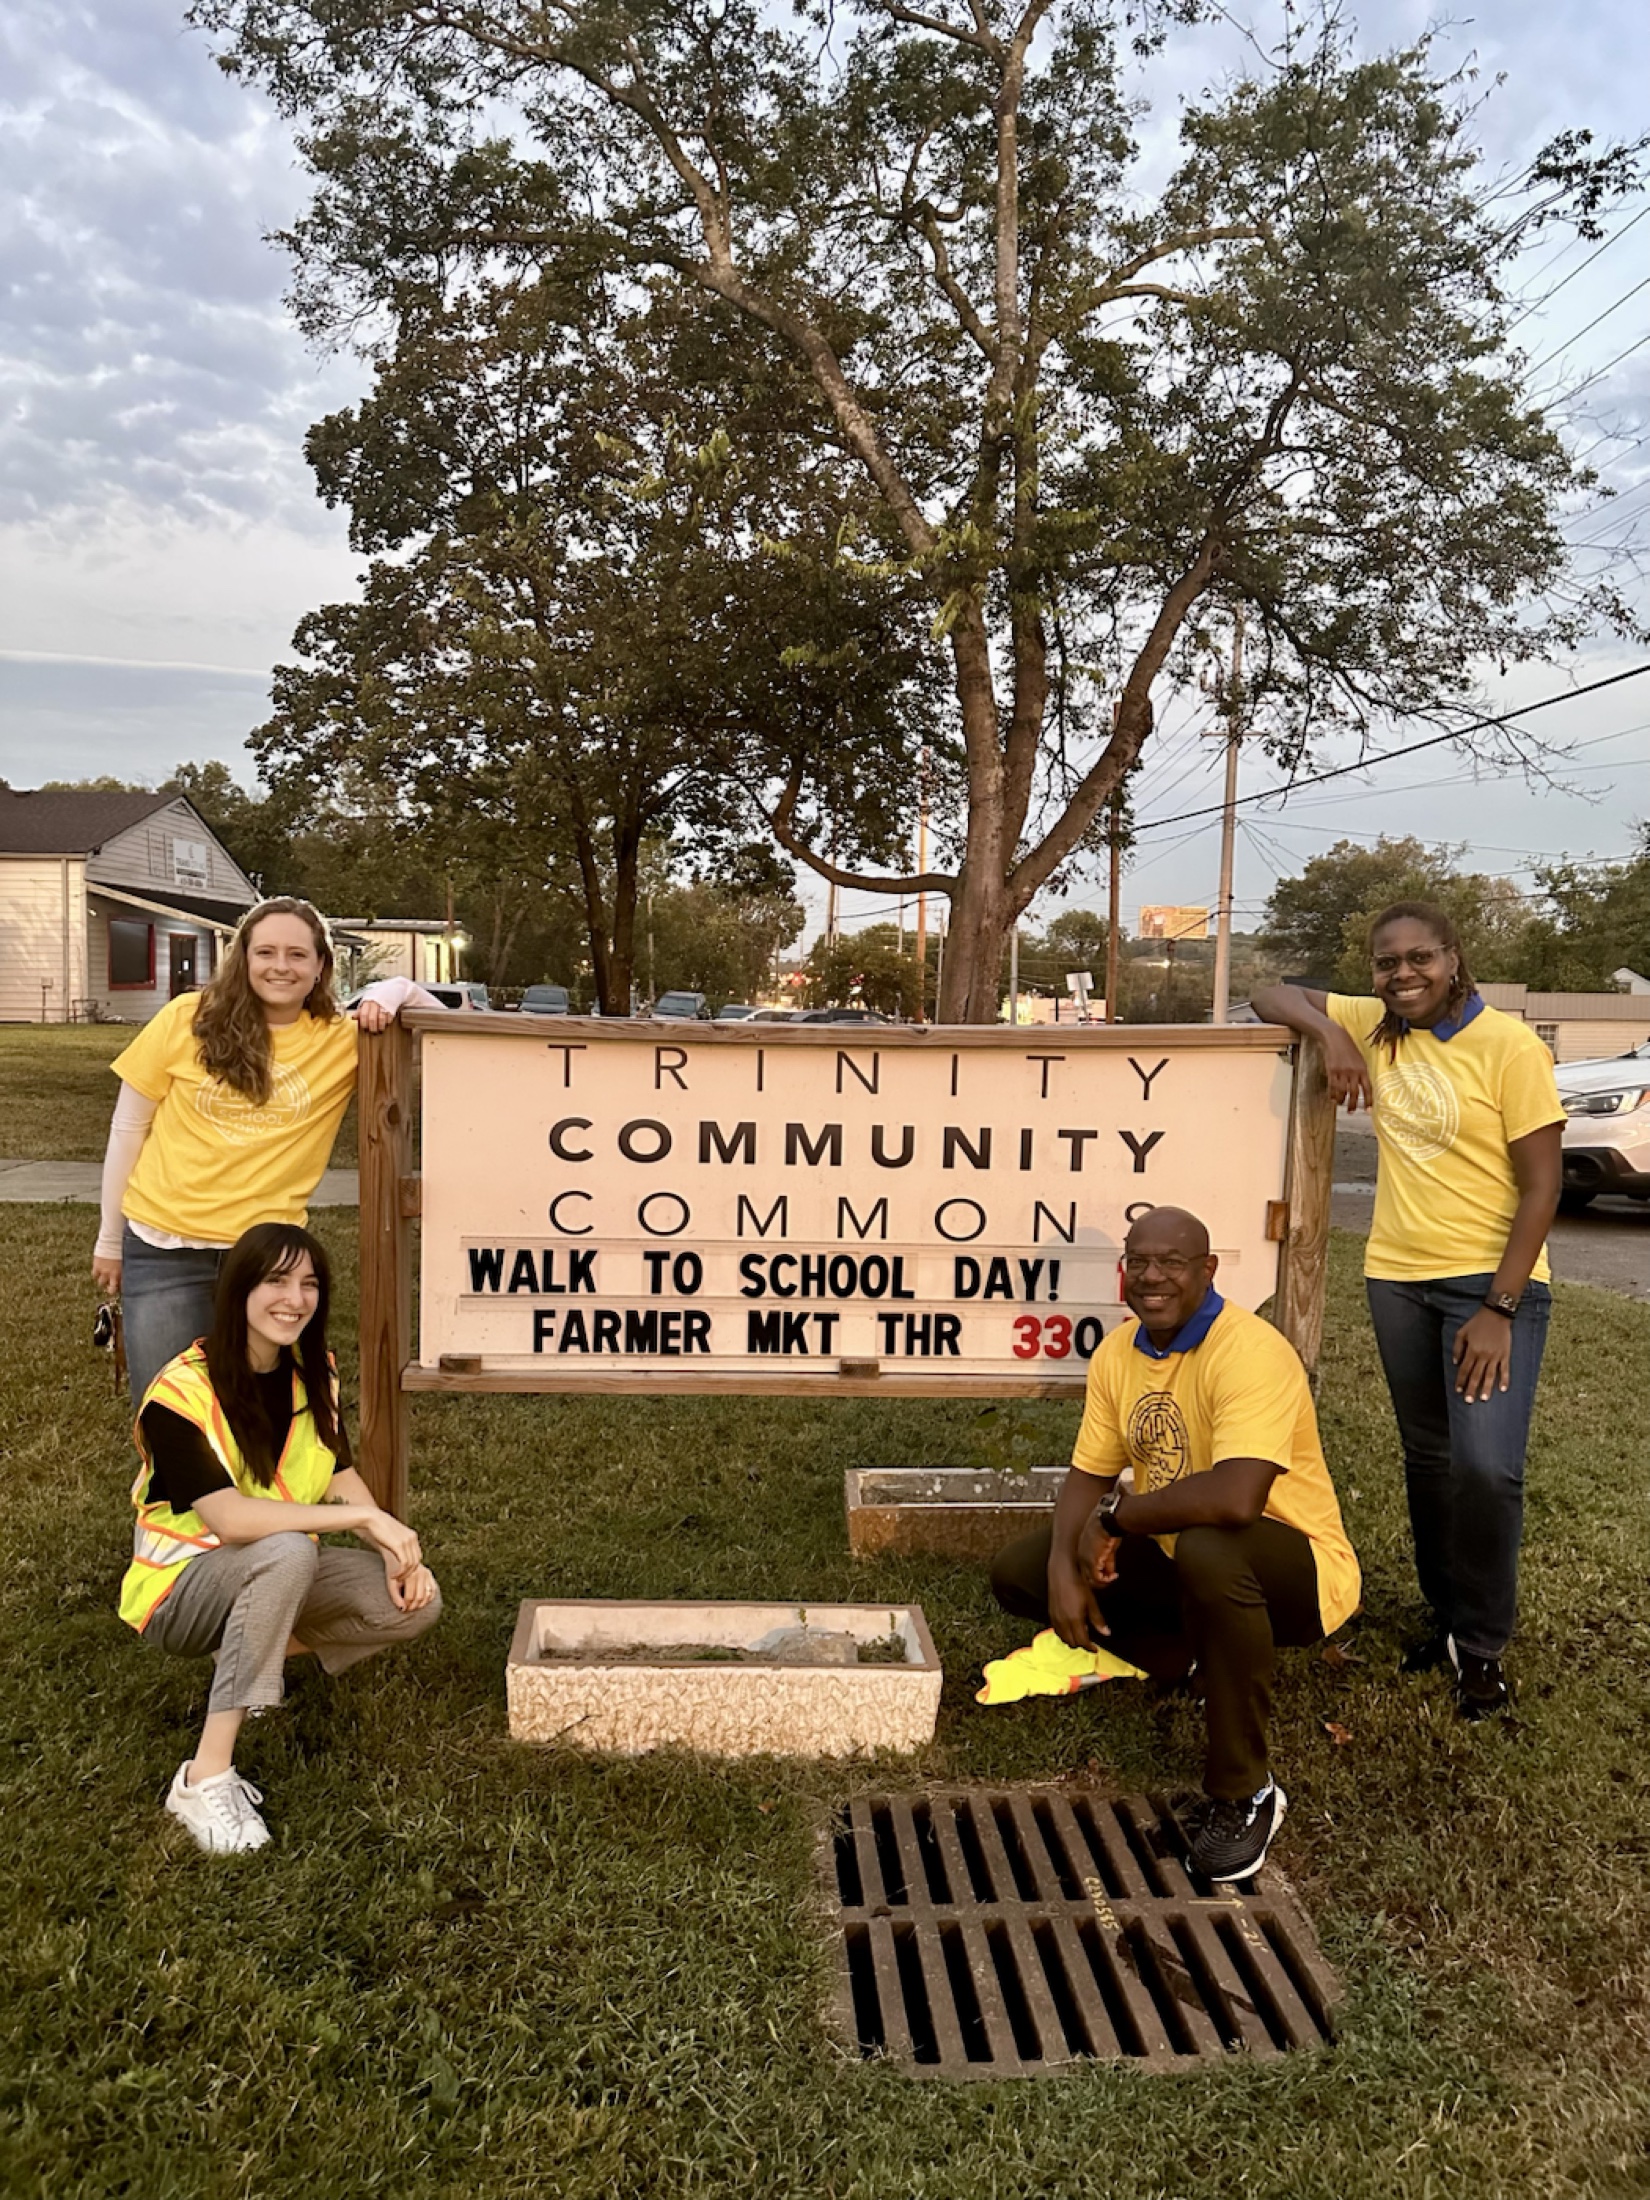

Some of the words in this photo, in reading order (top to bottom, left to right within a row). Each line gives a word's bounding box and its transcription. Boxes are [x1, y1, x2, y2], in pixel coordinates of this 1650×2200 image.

[548, 1044, 1170, 1100] TRINITY
[219, 1109, 286, 1125] SCHOOL
[549, 1117, 1166, 1173] COMMUNITY
[468, 1248, 598, 1294] WALK
[643, 1250, 703, 1296] TO
[739, 1253, 915, 1299] SCHOOL
[954, 1256, 1061, 1302] DAY!
[533, 1309, 713, 1354] FARMER
[747, 1310, 840, 1355] MKT
[876, 1312, 962, 1356] THR
[1012, 1314, 1105, 1360] 330
